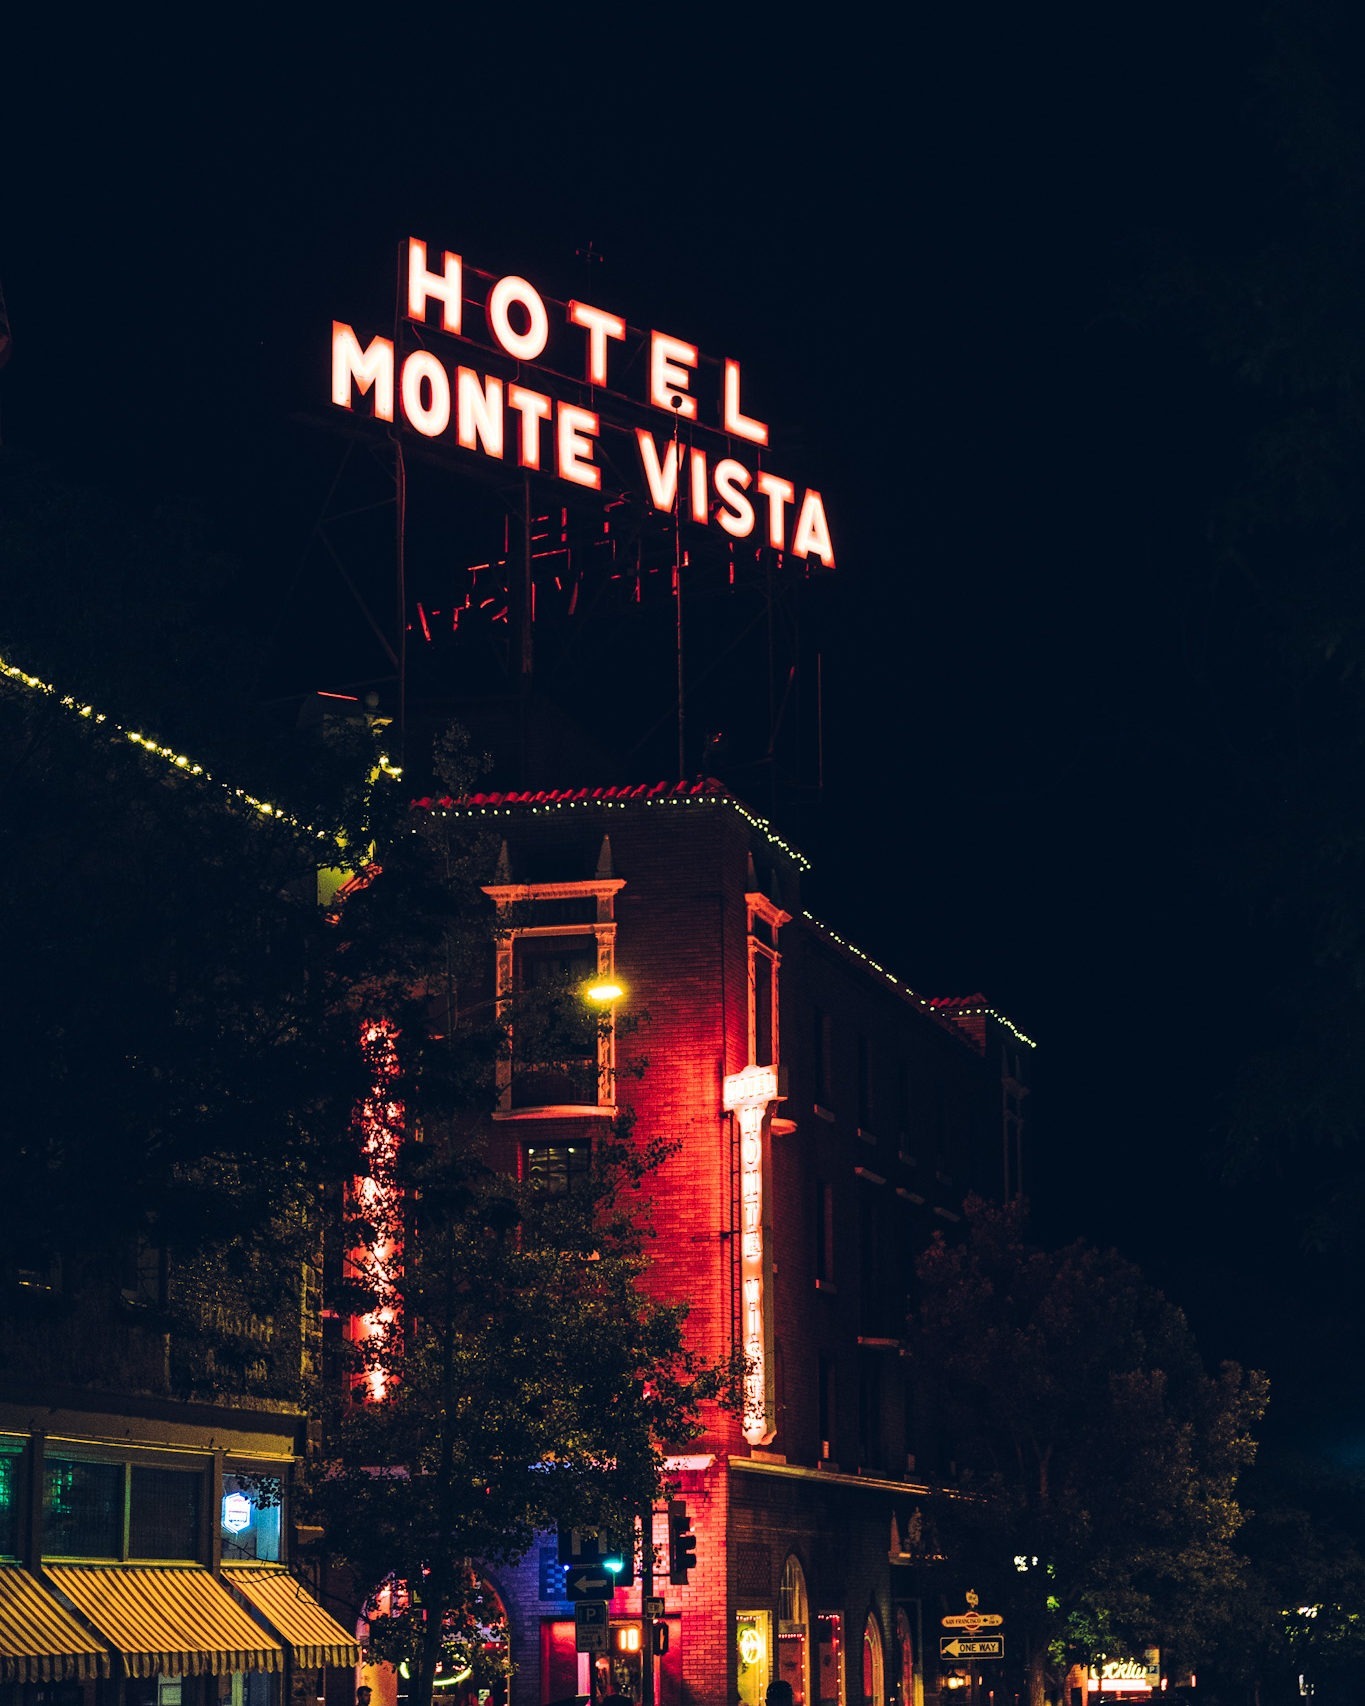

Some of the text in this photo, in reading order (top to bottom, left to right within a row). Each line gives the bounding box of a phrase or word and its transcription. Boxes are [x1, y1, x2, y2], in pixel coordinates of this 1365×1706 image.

[407, 236, 769, 447] HOTEL
[332, 319, 836, 570] MONTE VISTA
[586, 1608, 596, 1622] P
[959, 1643, 996, 1652] ONE WAY
